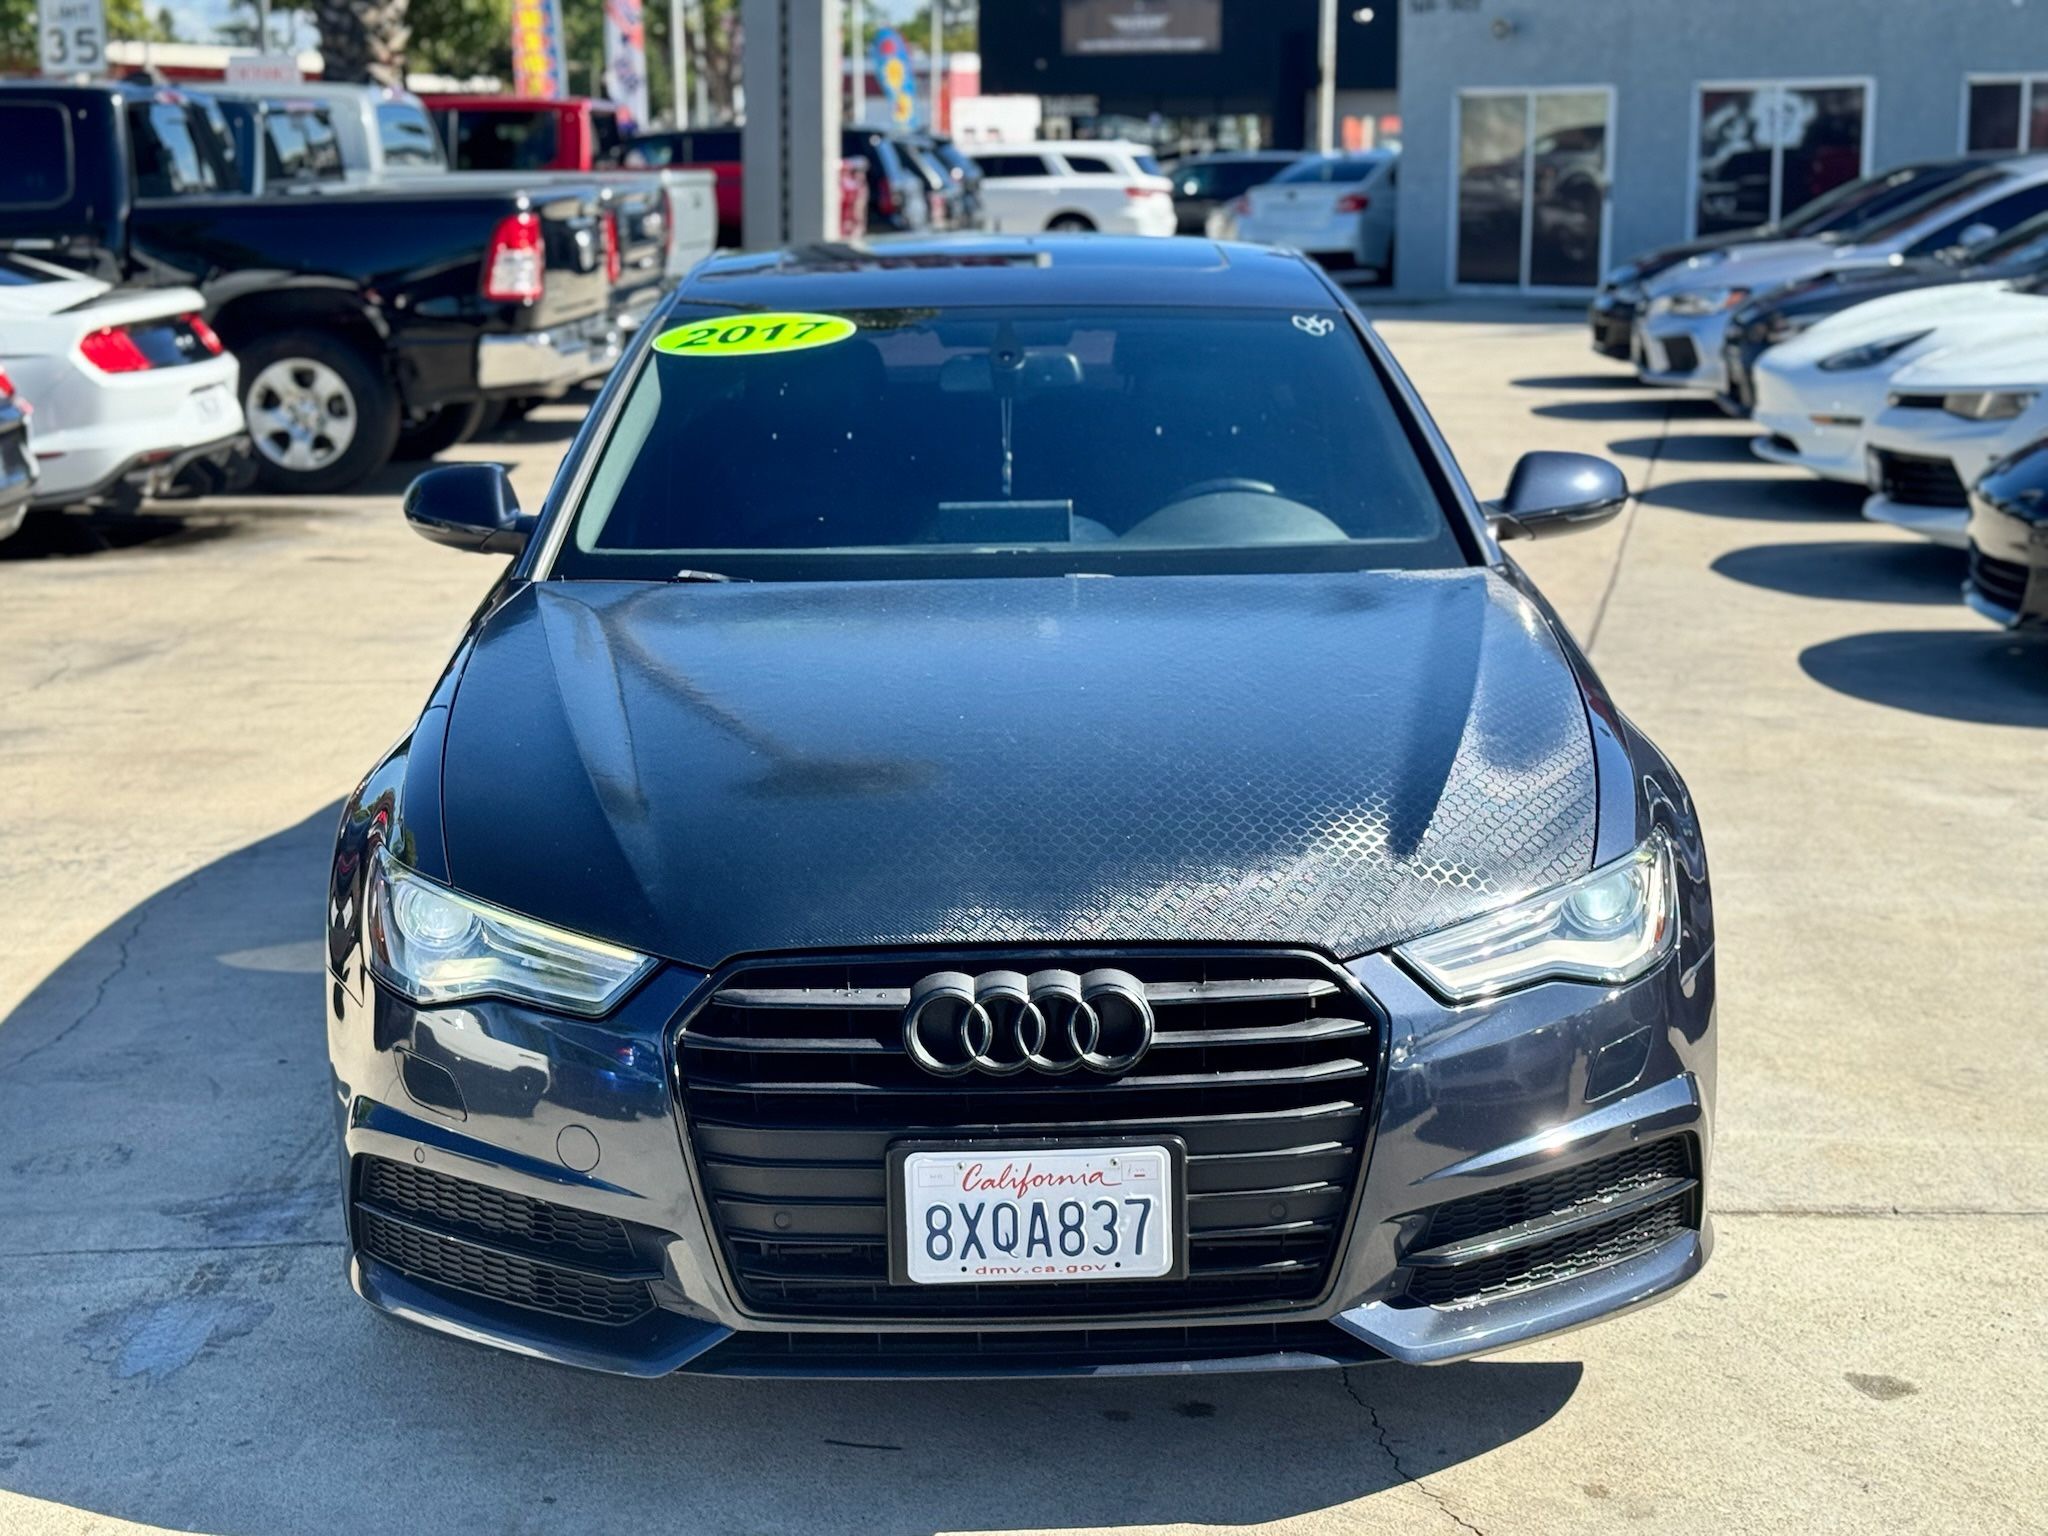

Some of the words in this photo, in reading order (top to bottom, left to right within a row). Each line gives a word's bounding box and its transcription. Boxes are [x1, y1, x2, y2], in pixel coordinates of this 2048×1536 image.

[48, 27, 99, 64] 35
[674, 321, 832, 350] 2017
[962, 1162, 1122, 1199] California
[925, 1198, 1152, 1261] 8XQA837
[975, 1262, 1107, 1275] dmv.ca.gov
